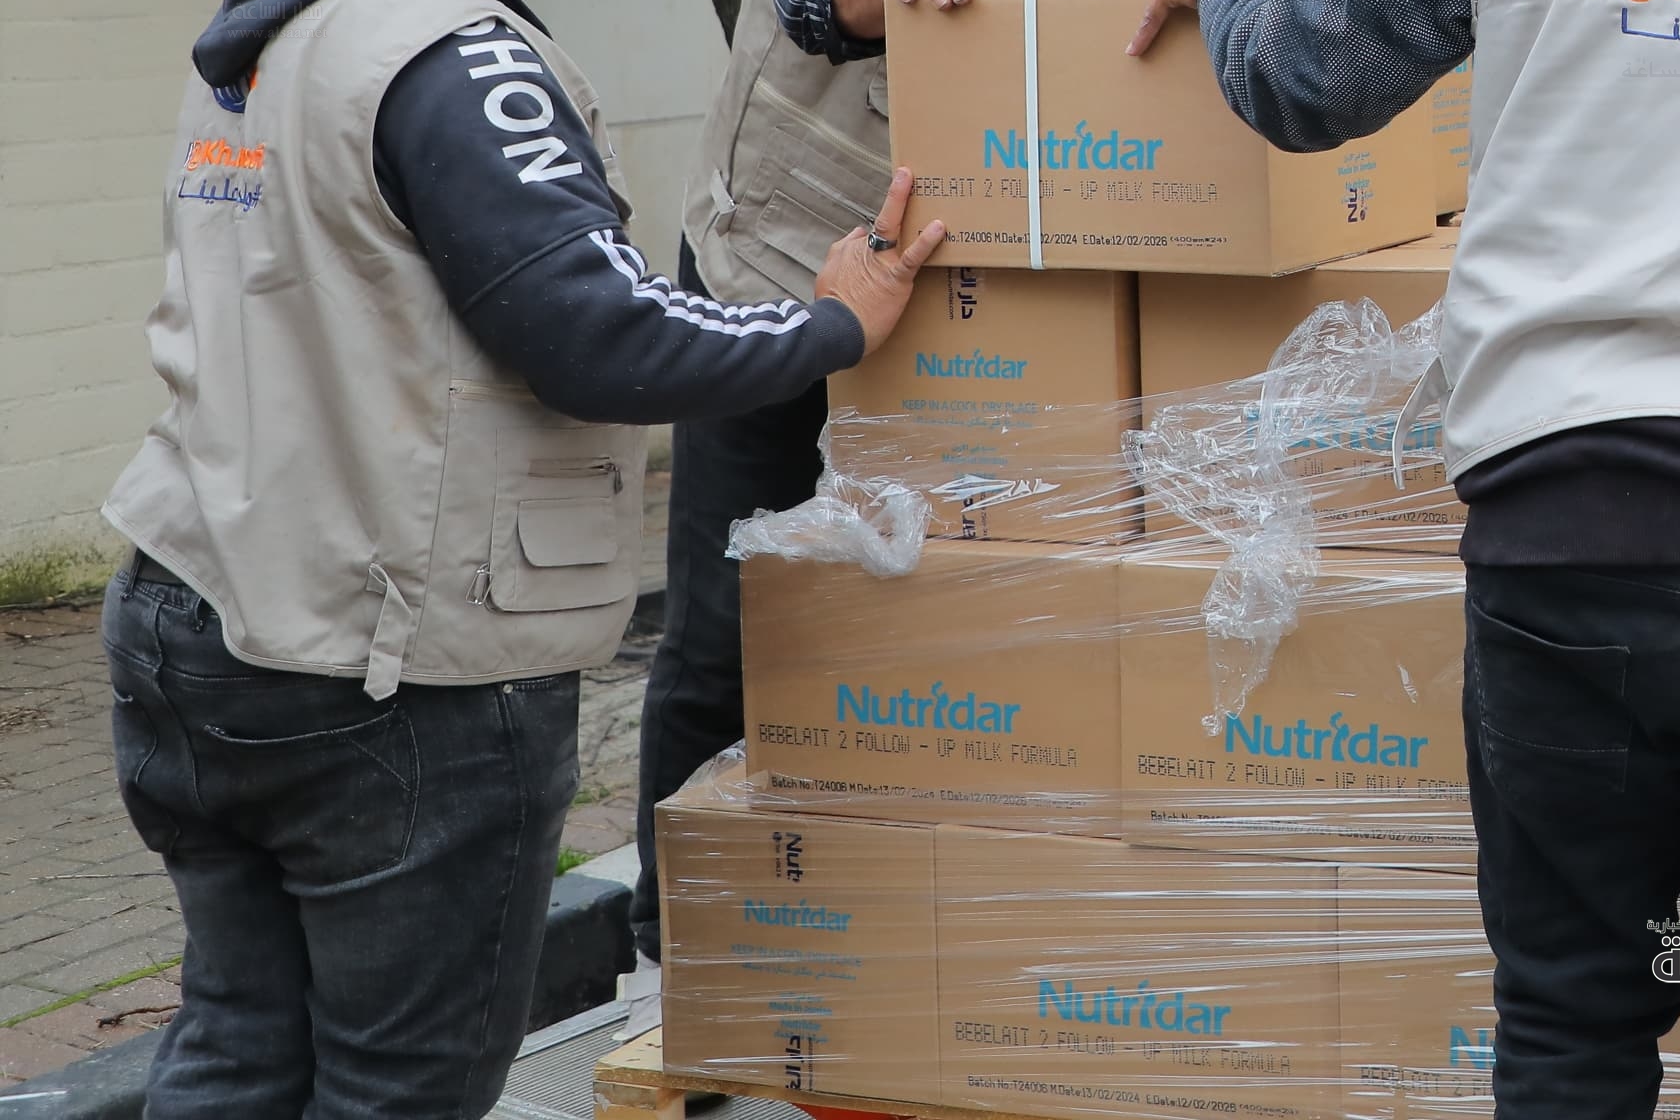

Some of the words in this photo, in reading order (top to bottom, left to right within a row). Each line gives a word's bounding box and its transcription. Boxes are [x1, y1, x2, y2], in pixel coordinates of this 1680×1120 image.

[453, 19, 583, 184] HON
[985, 179, 993, 197] 2
[1001, 179, 1055, 198] FOLOW
[1080, 180, 1098, 200] UP
[1106, 181, 1143, 201] MILK
[1152, 182, 1217, 203] FORMULA
[916, 349, 1028, 379] Nutridar
[837, 681, 1021, 733] Nutridar
[759, 724, 829, 747] BEBELAIT
[839, 730, 848, 749] 2
[856, 732, 911, 755] FOLLOW
[937, 737, 956, 758] UP
[965, 742, 1003, 763] MILK
[1011, 744, 1080, 767] FORMULA
[1225, 712, 1428, 768] Nutridar
[1137, 755, 1215, 780] BEBELAIT
[1226, 763, 1236, 783] 2
[1246, 764, 1305, 788] FOLLOW
[1335, 771, 1357, 790] UP
[744, 898, 853, 932] Nutridar
[1038, 979, 1232, 1036] Nutridar
[954, 1021, 1030, 1047] BEBELAIT
[1040, 1029, 1049, 1049] 2
[1057, 1031, 1115, 1056] FOLLOW
[1172, 1044, 1211, 1068] MILK
[1220, 1049, 1292, 1074] FORMULA
